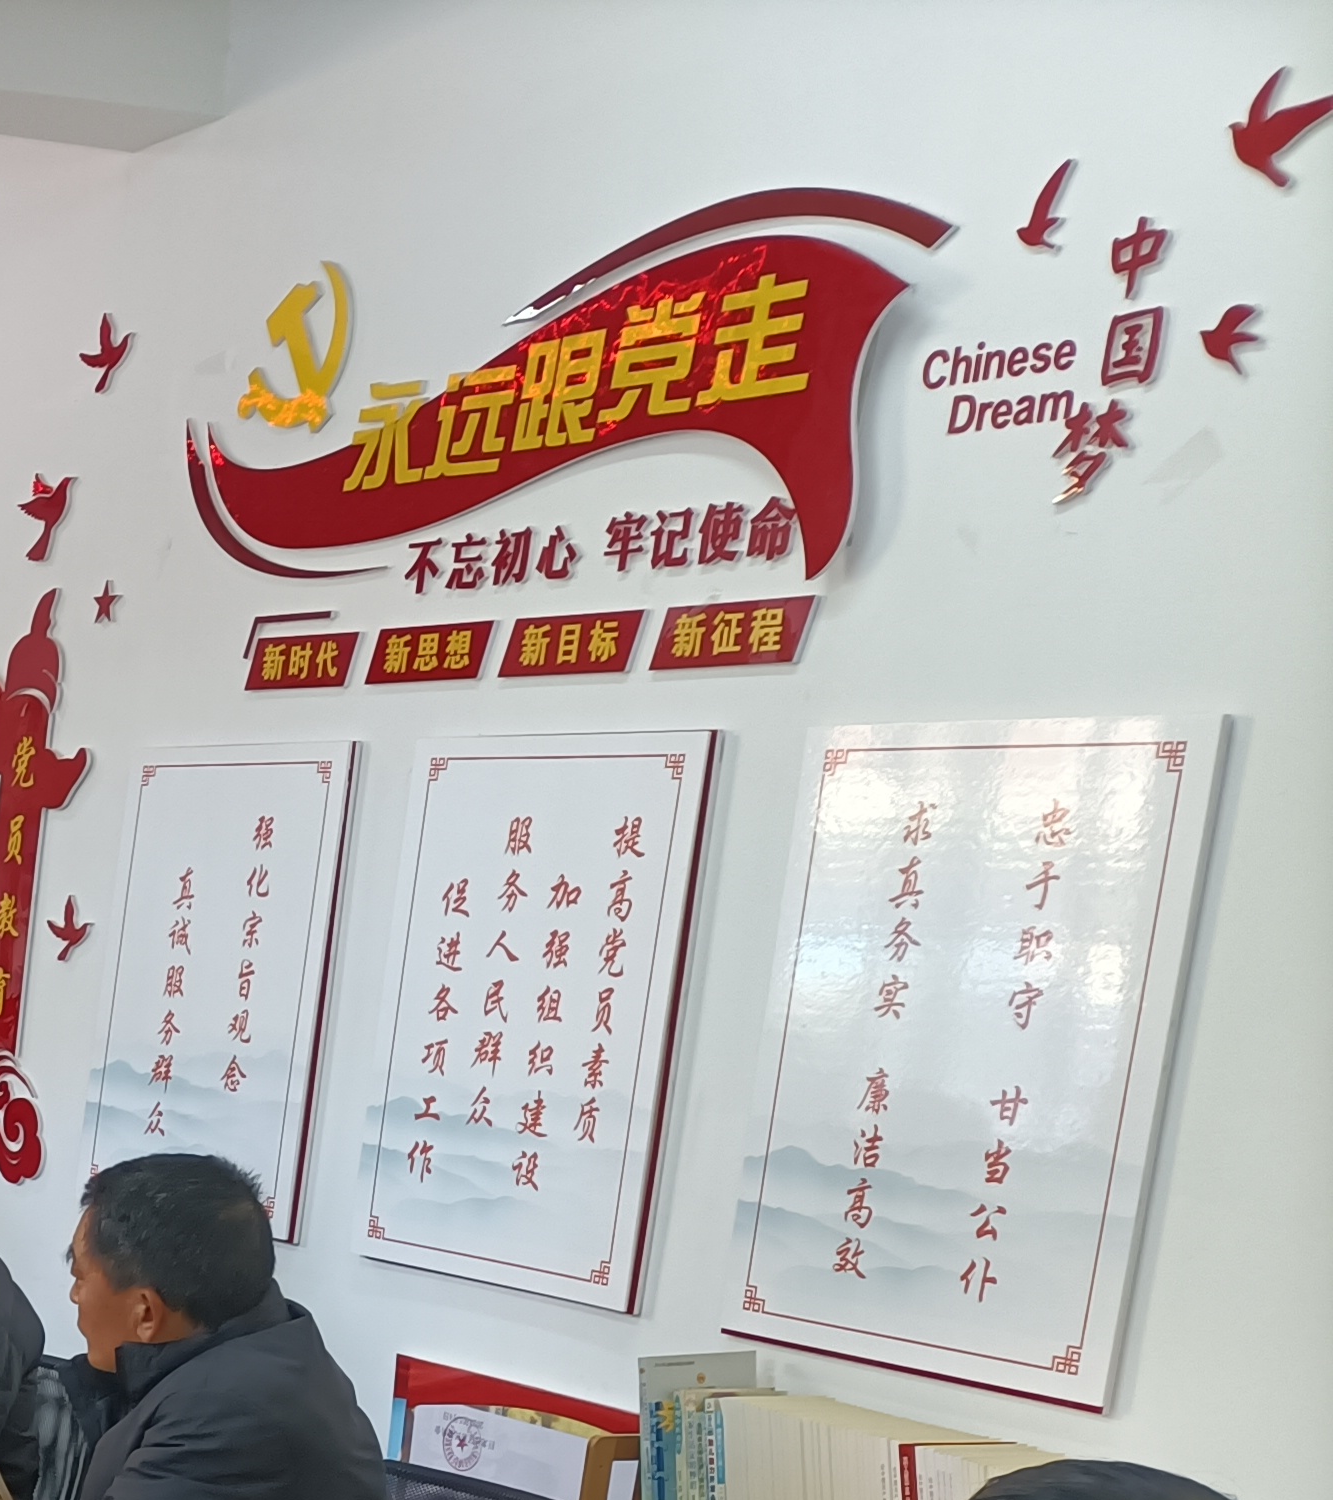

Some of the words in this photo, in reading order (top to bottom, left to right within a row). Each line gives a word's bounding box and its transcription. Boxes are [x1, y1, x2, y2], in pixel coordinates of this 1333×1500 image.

[342, 273, 810, 493] 永远跟党走
[923, 340, 1077, 390] Chinese
[947, 390, 1075, 435] Dream
[1052, 216, 1167, 503] 中国梦
[383, 629, 472, 675] 新思想
[405, 524, 579, 594] 不忘初心
[604, 496, 798, 572] 牢记使命
[518, 618, 619, 666] 新目标
[671, 606, 784, 659] 新征程
[261, 640, 339, 681] 新时代
[143, 866, 195, 1137] 真诚服务群众
[221, 815, 275, 1093] 强化宗旨观念
[465, 816, 533, 1129] 服务人民群众
[573, 816, 646, 1144] 提高党员素质
[873, 801, 938, 1020] 求真务实
[1007, 798, 1072, 1030] 忠于职守
[407, 878, 470, 1184] 促进各项工作
[511, 873, 582, 1192] 加强组织建设
[833, 1067, 890, 1280] 廉洁高效
[960, 1086, 1028, 1303] 甘当公仆
